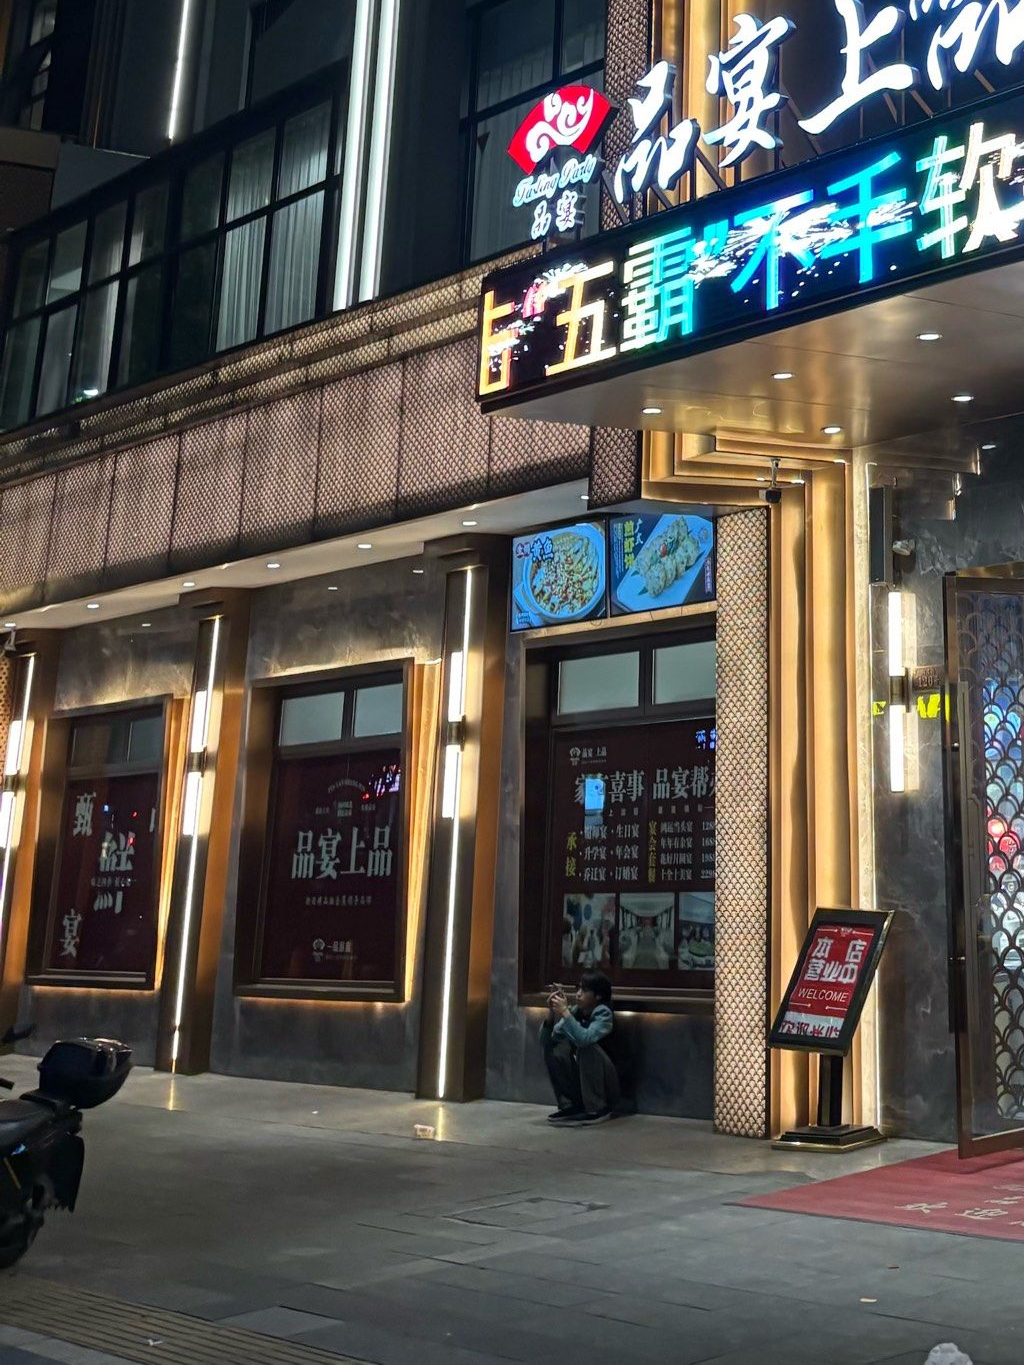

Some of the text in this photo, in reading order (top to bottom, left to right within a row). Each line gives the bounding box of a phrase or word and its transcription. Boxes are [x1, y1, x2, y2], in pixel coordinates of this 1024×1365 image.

[513, 154, 597, 207] Tasting Party
[531, 190, 578, 239] 品宴
[291, 824, 393, 880] 品宴上品
[565, 831, 577, 877] 承接
[59, 907, 82, 958] 宴
[798, 988, 849, 1003] WELCOME
[804, 958, 858, 984] 营业中
